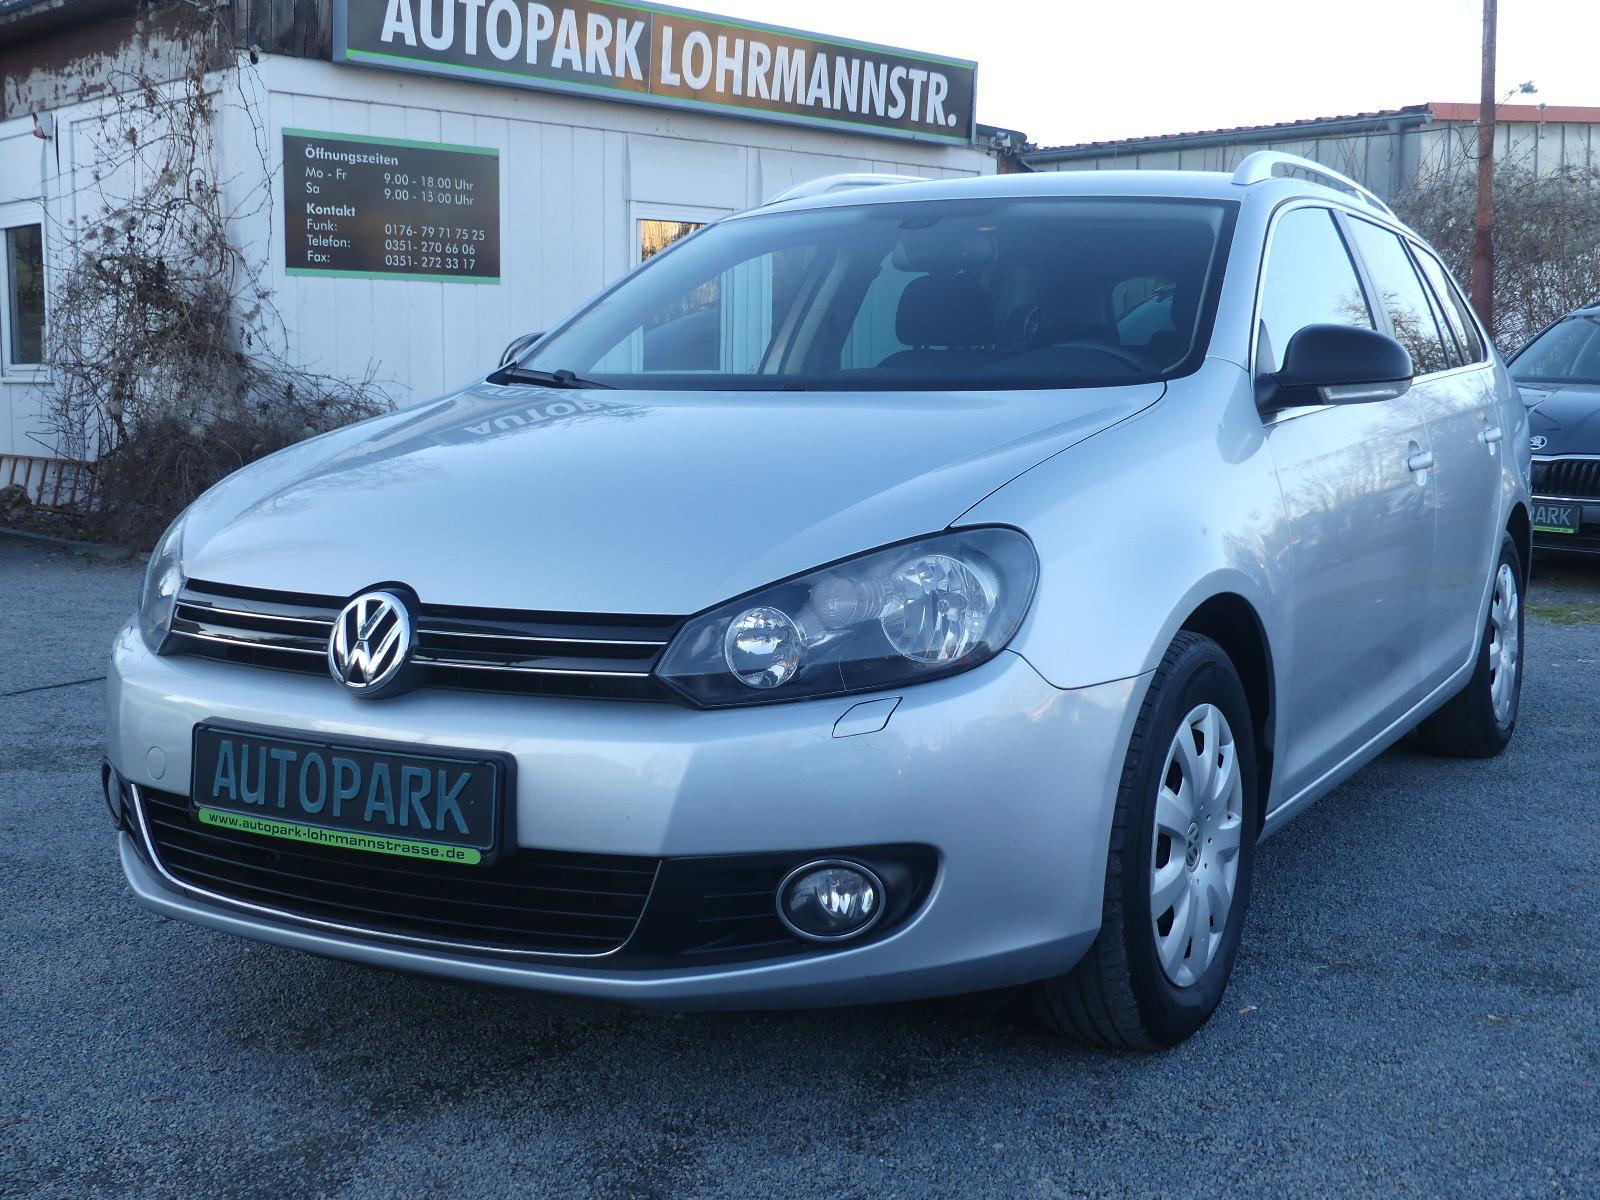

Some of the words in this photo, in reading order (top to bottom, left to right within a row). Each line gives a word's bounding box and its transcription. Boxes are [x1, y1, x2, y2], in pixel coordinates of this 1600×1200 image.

[381, 0, 645, 81] AUTOPARK
[660, 26, 958, 128] LOHRMANNSTR.
[305, 144, 399, 166] Öffnungszeiten
[305, 166, 324, 178] Mo
[336, 168, 348, 180] Fr
[384, 173, 409, 185] 9.00
[421, 176, 451, 189] 18.00
[455, 179, 474, 190] Uhr
[306, 181, 320, 194] Sa
[384, 188, 409, 200] 9.00
[455, 194, 474, 206] Uhr
[306, 202, 356, 217] Kontakt
[307, 218, 338, 231] Funk:
[421, 226, 435, 238] 79
[438, 227, 450, 239] 71
[456, 228, 469, 240] 75
[472, 229, 485, 241] 25
[307, 234, 351, 248] Telefon:
[421, 241, 442, 253] 270
[445, 243, 459, 254] 66
[462, 244, 476, 255] 06
[307, 250, 331, 263] Fax:
[421, 256, 441, 268] 272
[445, 258, 459, 269] 33
[463, 259, 476, 270] 17
[212, 740, 472, 835] AUTOPARK
[208, 810, 466, 861] www.autopark-lohrmannstrasse.de
